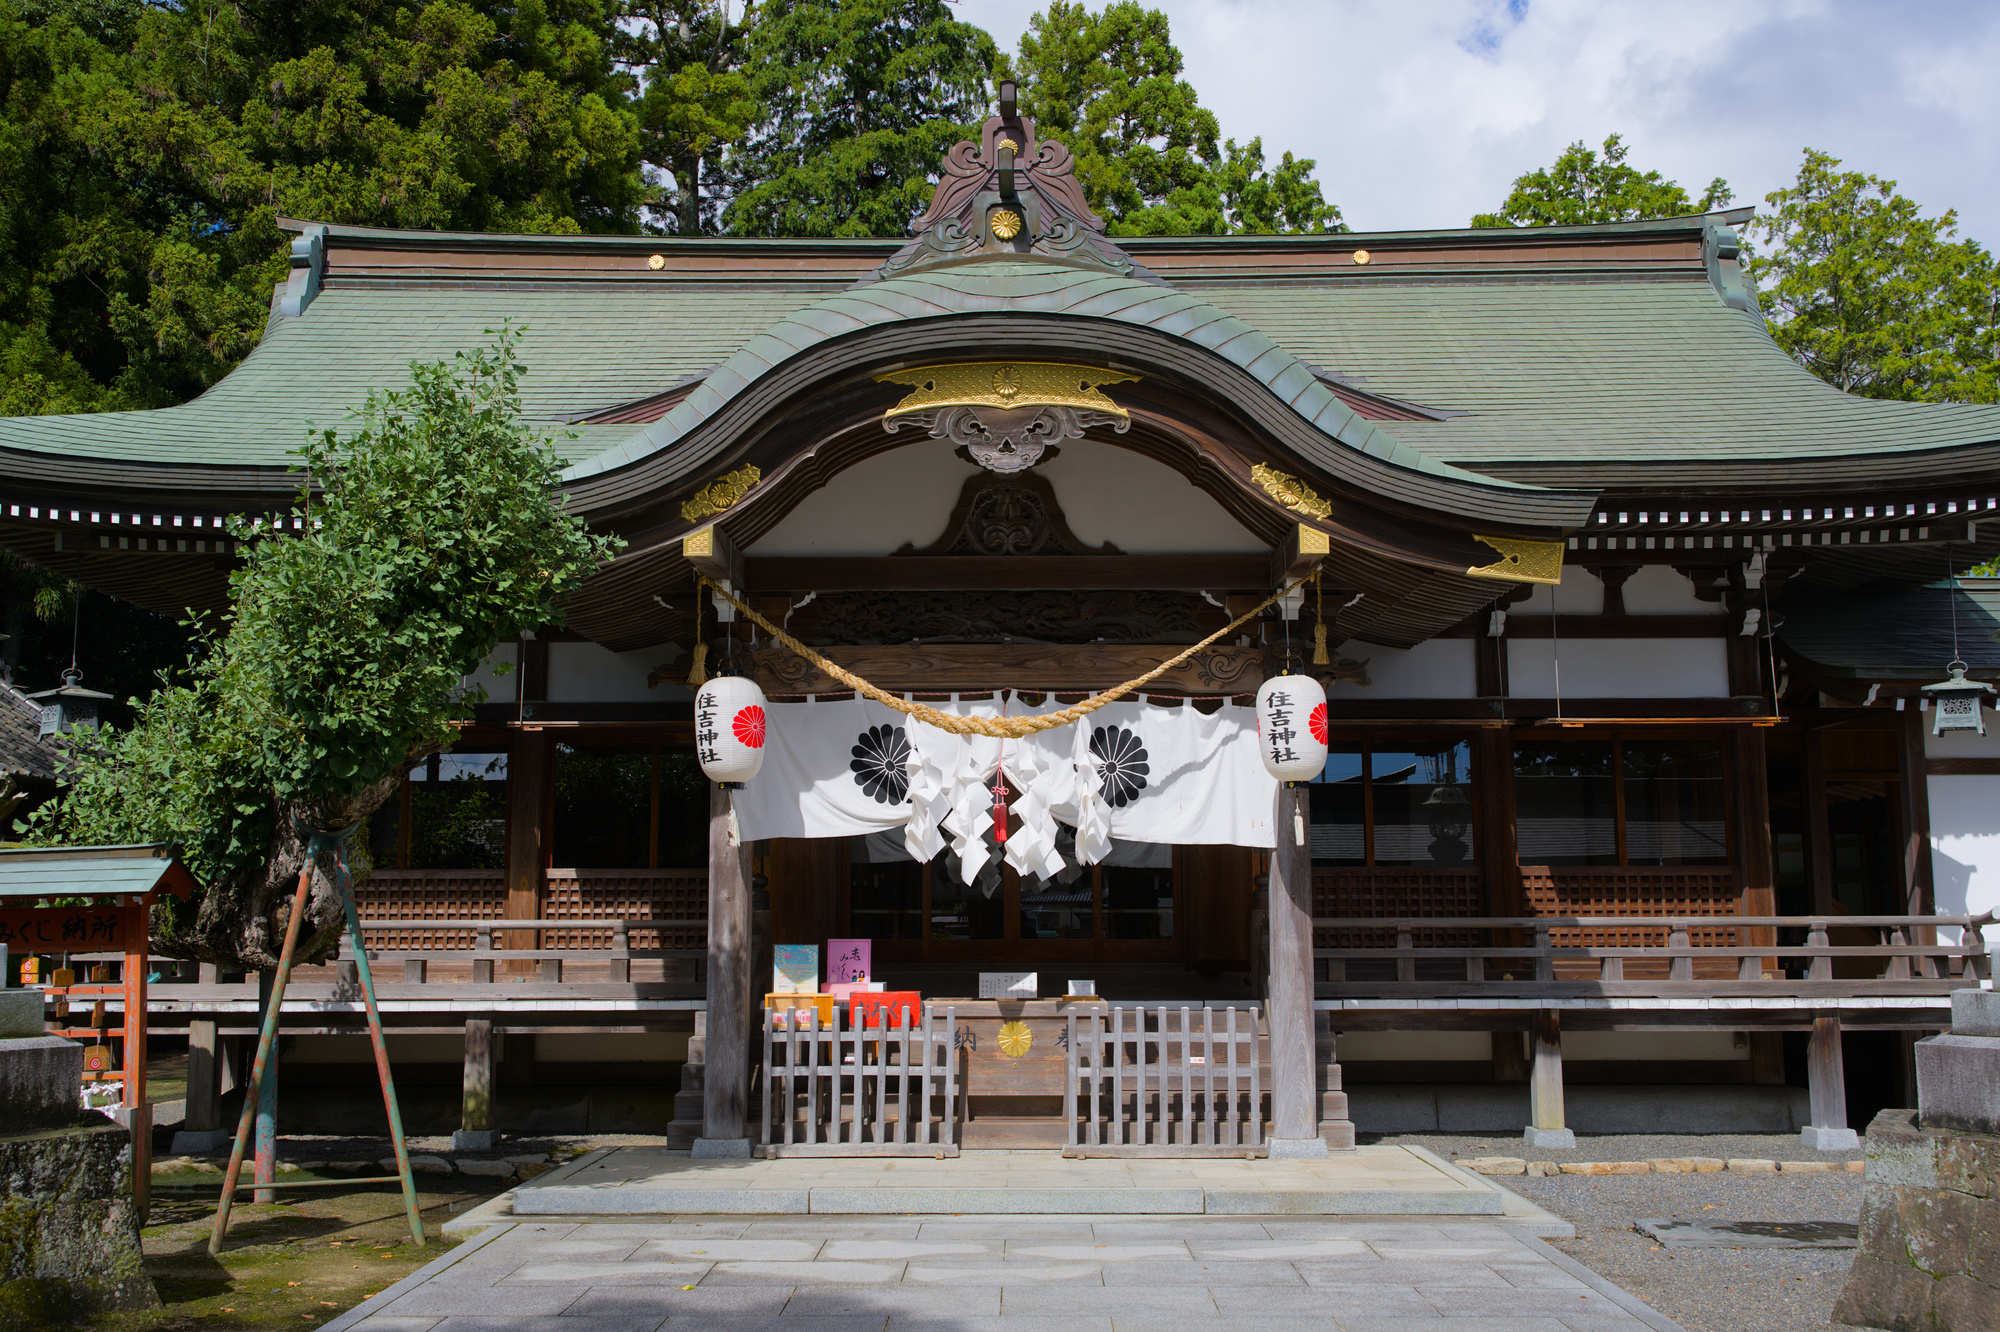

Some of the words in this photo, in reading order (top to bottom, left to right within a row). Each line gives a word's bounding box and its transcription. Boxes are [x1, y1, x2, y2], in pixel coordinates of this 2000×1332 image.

[697, 692, 722, 765] 住吉神社
[1265, 691, 1300, 764] 住吉神社
[857, 1000, 913, 1020] おみく
[954, 1025, 977, 1052] 納
